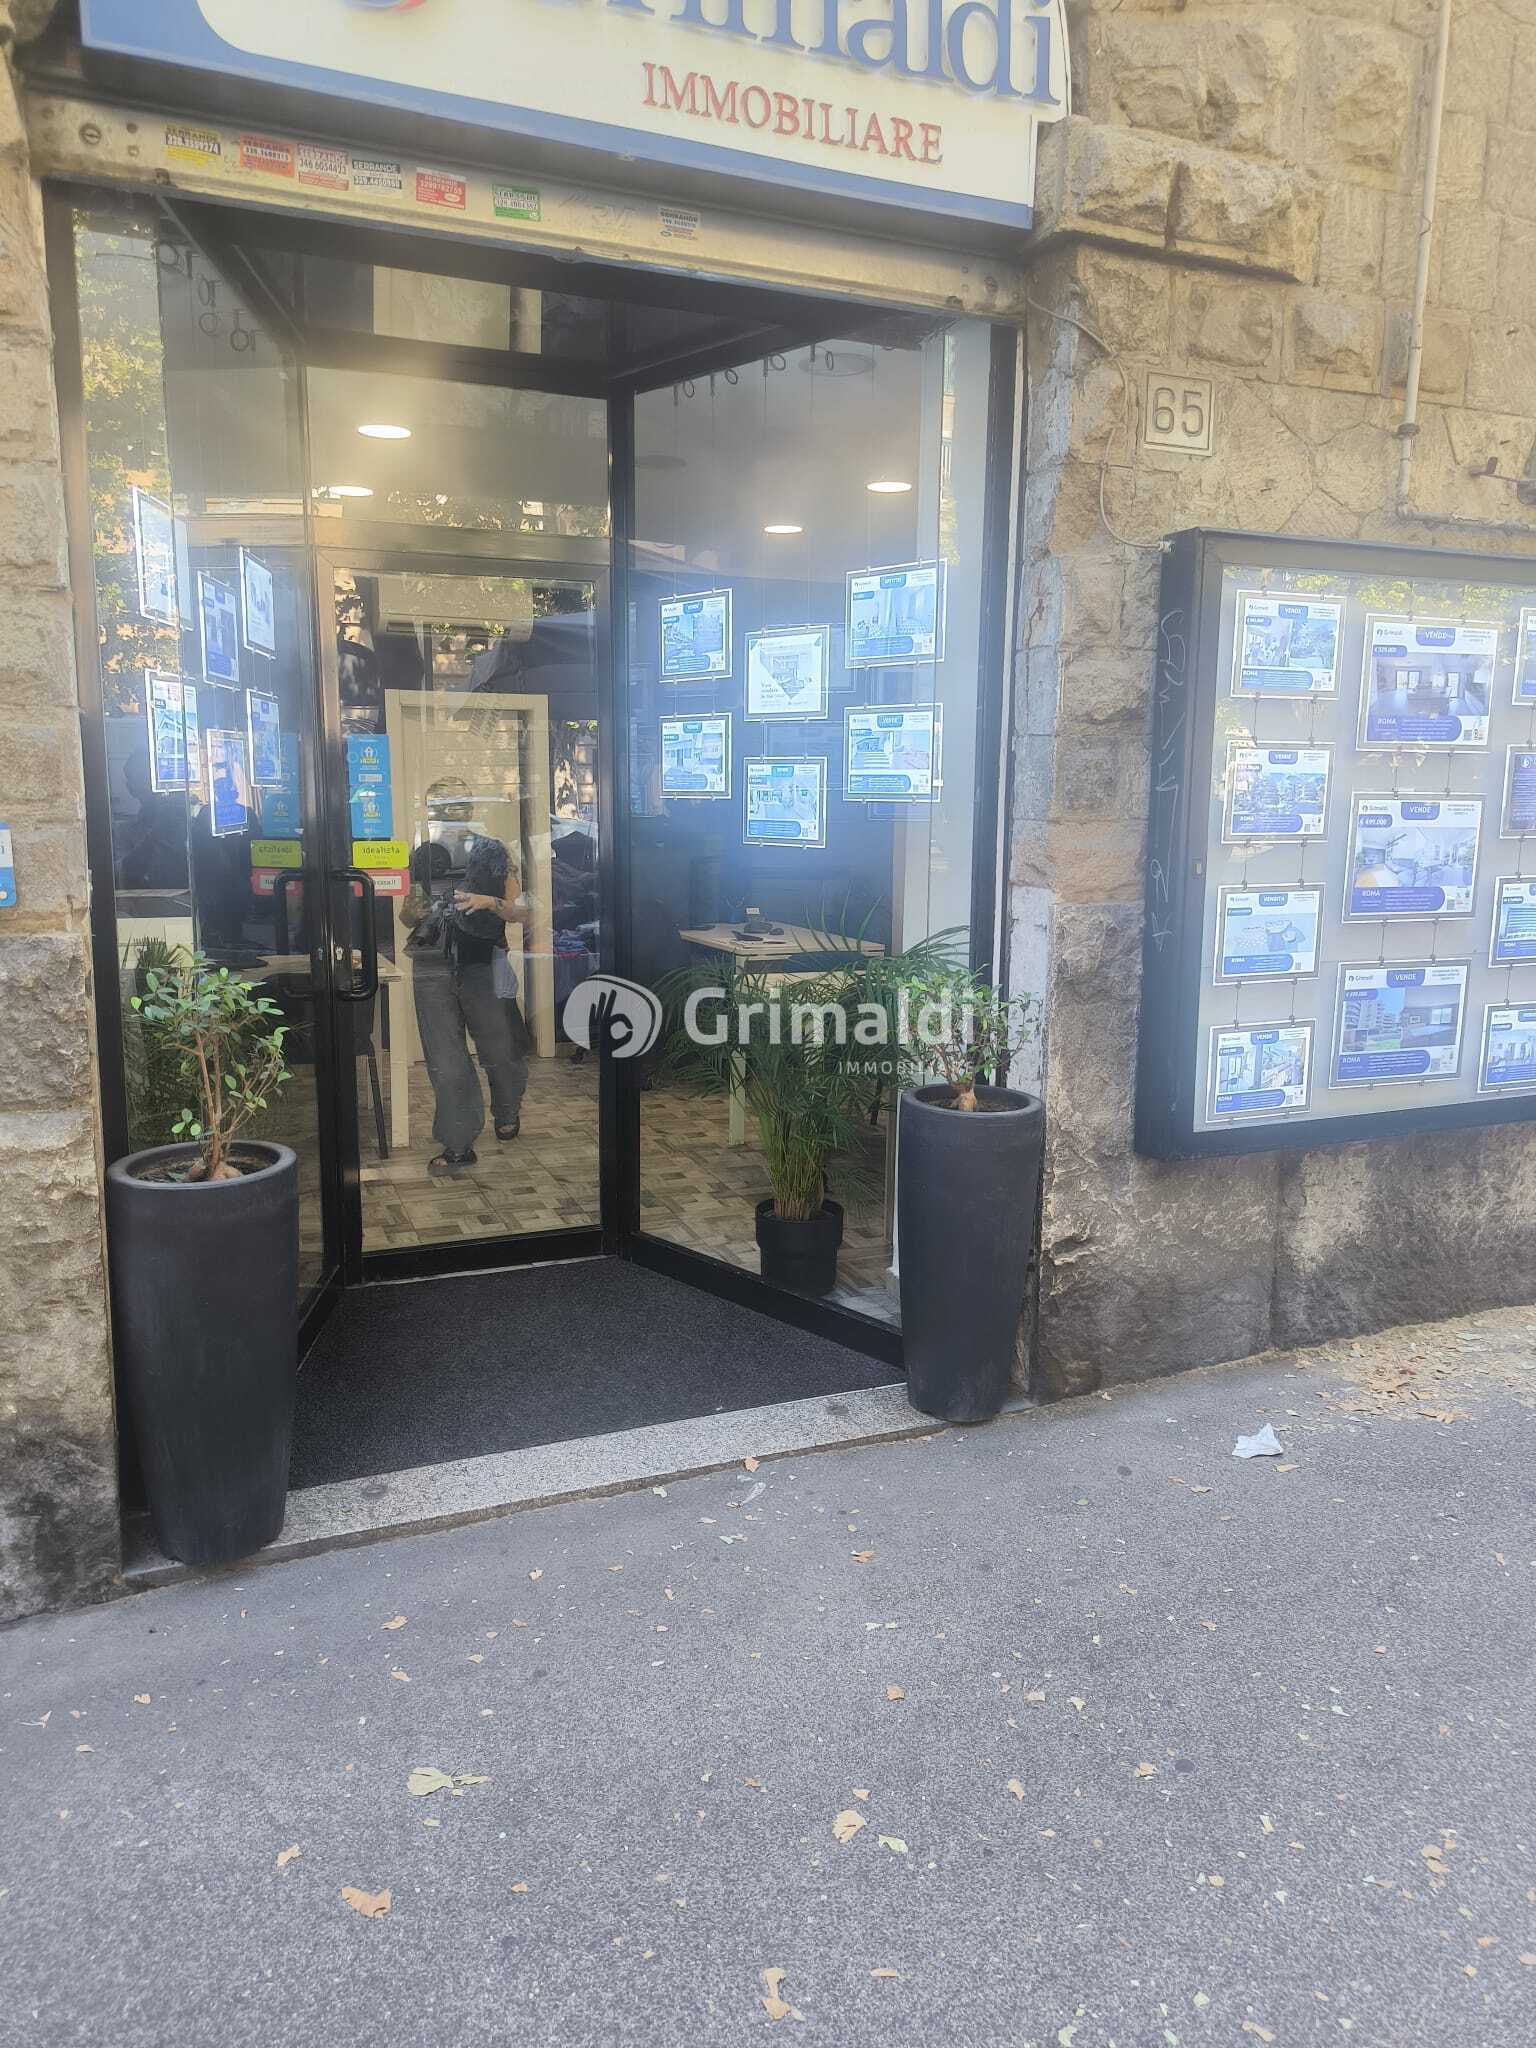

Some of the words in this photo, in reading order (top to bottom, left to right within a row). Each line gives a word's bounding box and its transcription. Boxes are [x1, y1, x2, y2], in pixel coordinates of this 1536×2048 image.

[641, 61, 944, 166] IMMOBILIARE
[352, 160, 400, 173] SERRANDE
[1153, 386, 1204, 437] 65
[1425, 631, 1447, 640] VENDE
[1377, 718, 1397, 726] ROMA
[1409, 806, 1432, 814] VENDE
[1395, 973, 1417, 981] VENDE
